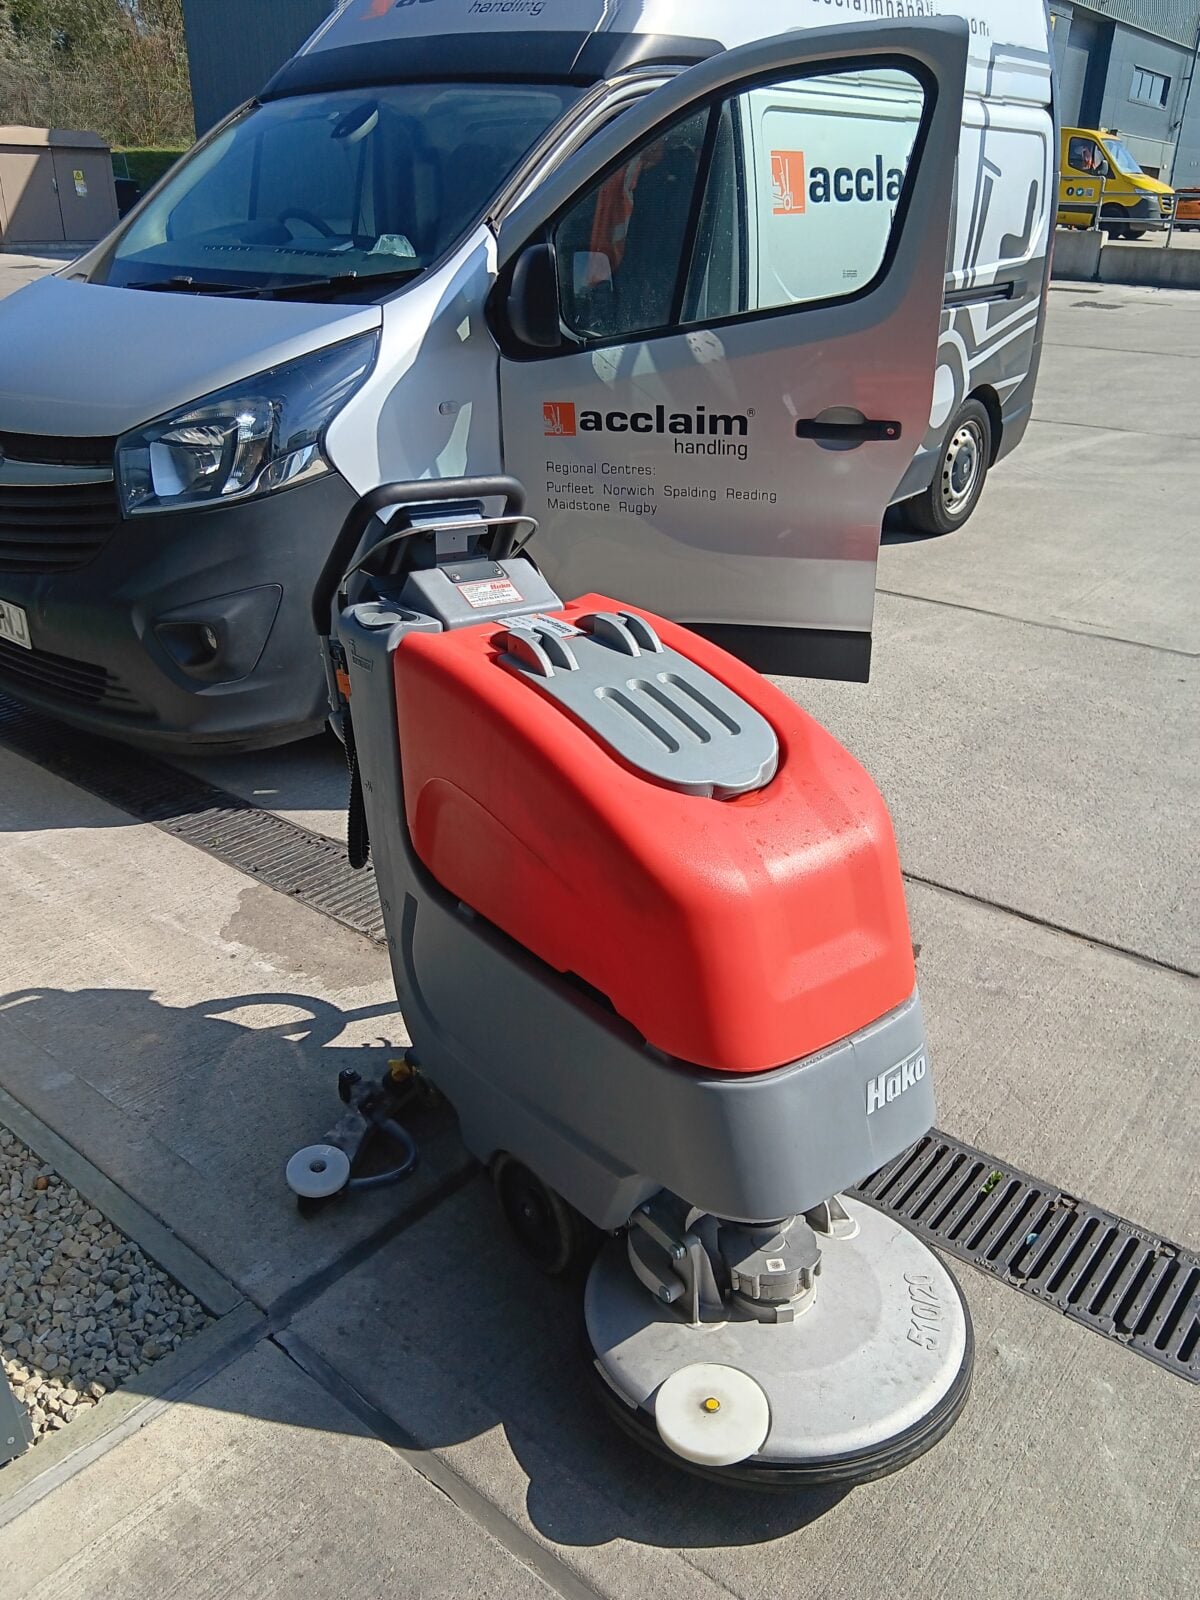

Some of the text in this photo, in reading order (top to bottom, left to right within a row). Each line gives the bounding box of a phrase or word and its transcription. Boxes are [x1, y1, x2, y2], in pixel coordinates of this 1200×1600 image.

[809, 154, 906, 203] accla
[674, 437, 748, 460] handling
[546, 461, 656, 476] Regional Centres:
[546, 481, 777, 504] Purfleet Norwich Spalding Reading
[547, 498, 658, 516] Maidstone Rugby
[866, 1047, 926, 1115] Hako
